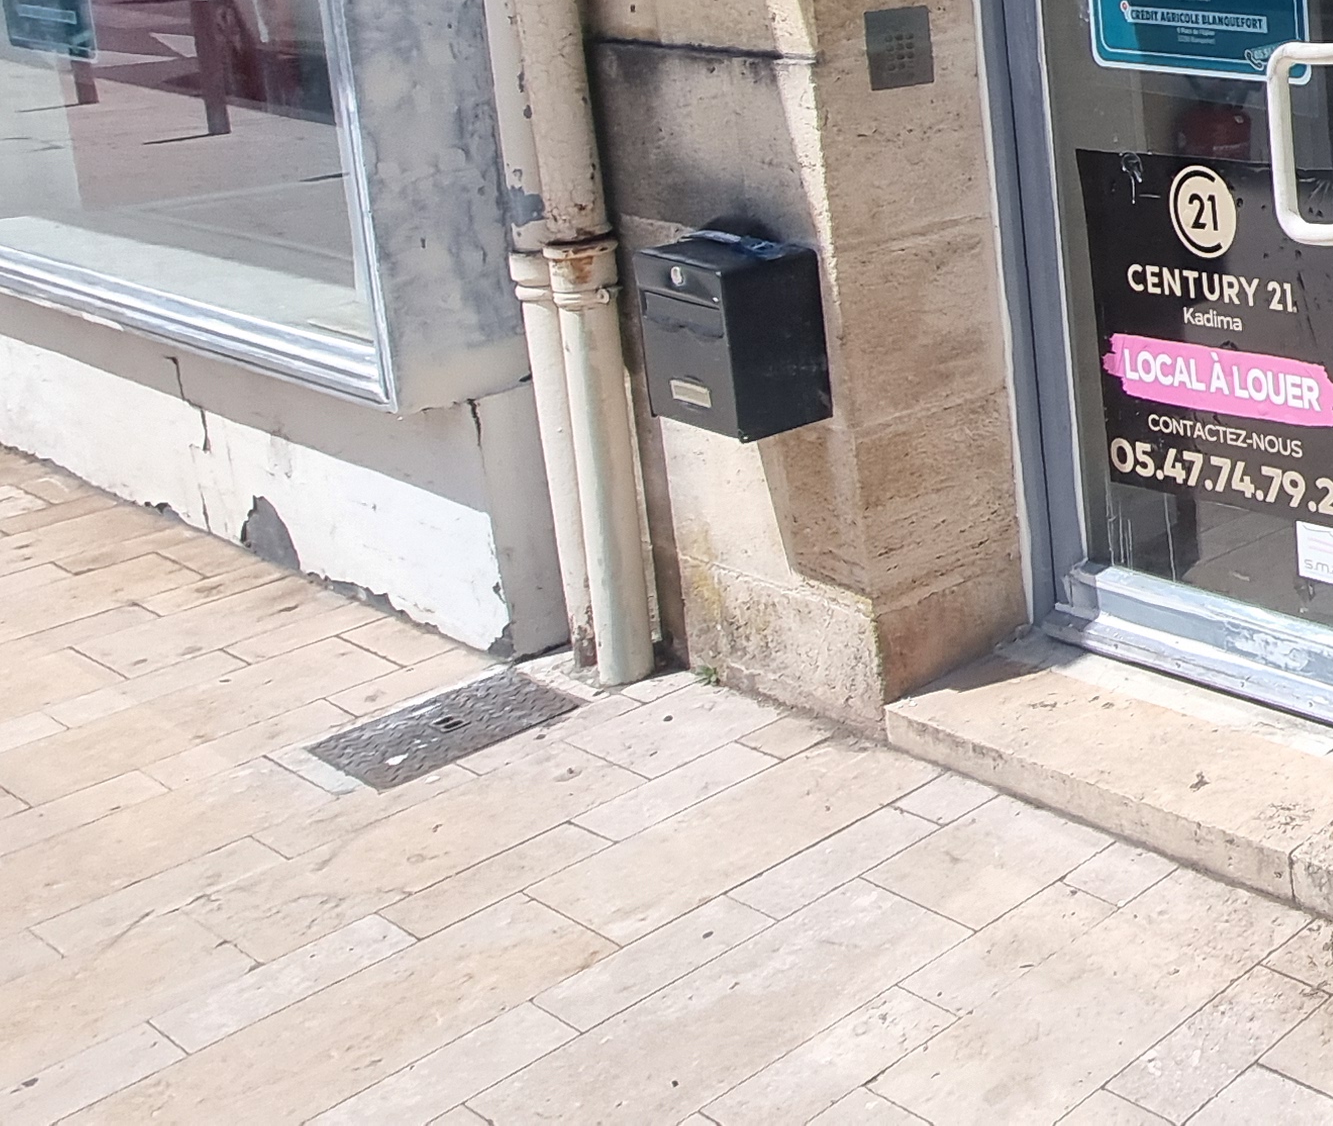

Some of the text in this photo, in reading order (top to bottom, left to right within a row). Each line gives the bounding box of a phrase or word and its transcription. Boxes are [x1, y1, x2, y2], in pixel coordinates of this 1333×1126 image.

[1188, 192, 1219, 232] 21
[1127, 263, 1260, 307] CENTURY
[1183, 307, 1243, 332] Kadima
[1123, 348, 1322, 411] LOCAL À LOUER
[1148, 414, 1303, 458] CONTACTEZ-NOUS
